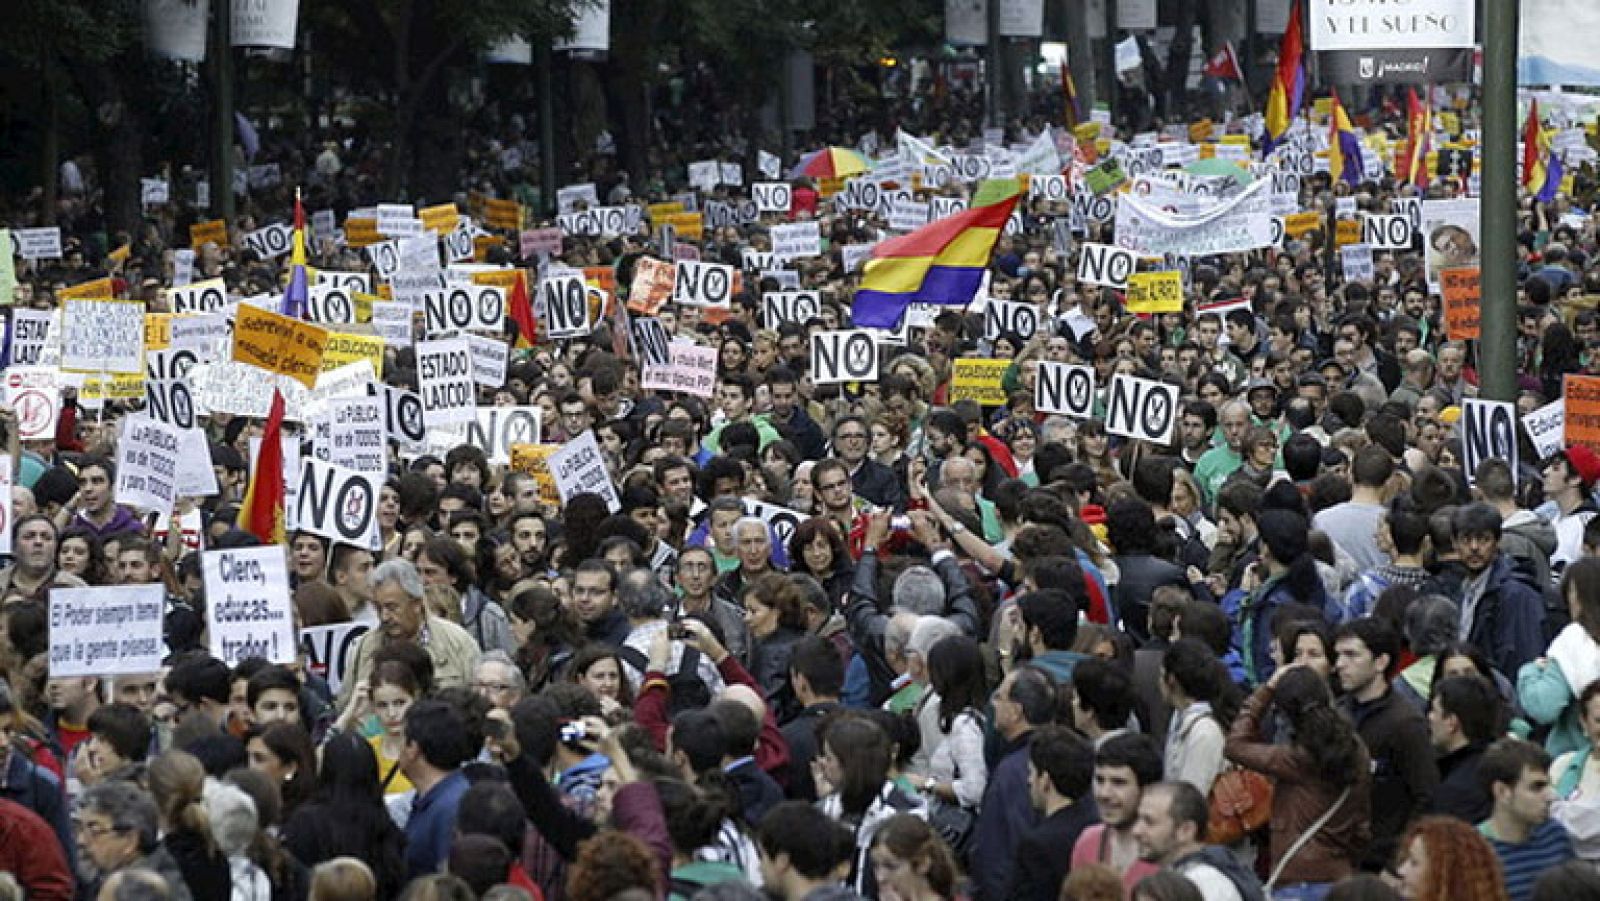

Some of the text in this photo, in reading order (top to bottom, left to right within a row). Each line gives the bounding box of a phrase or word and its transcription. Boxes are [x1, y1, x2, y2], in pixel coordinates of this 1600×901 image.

[755, 186, 788, 208] NO
[848, 181, 877, 207] NO
[1031, 177, 1063, 198] NO
[591, 209, 624, 231] NO
[1367, 216, 1409, 245] NO
[248, 226, 286, 256] NO
[1081, 247, 1133, 284] NO
[677, 263, 728, 304] NO
[545, 277, 587, 327] NO
[766, 295, 816, 328] NO
[985, 303, 1037, 340] NO
[420, 350, 467, 380] ESTADO
[813, 333, 875, 379] NO
[423, 382, 471, 411] LAICO!
[1038, 364, 1092, 413] NO
[147, 382, 193, 429] NO
[1110, 378, 1172, 438] NO
[354, 429, 381, 448] TODOS
[467, 411, 538, 457] NO
[1466, 402, 1513, 477] NO
[149, 451, 176, 479] TODOS
[298, 461, 373, 539] NO
[218, 552, 265, 586] Clero,
[65, 602, 93, 627] Poder
[95, 602, 133, 629] siempre
[135, 602, 160, 621] teme
[51, 644, 72, 665] que
[75, 638, 84, 662] la
[86, 640, 118, 666] gente
